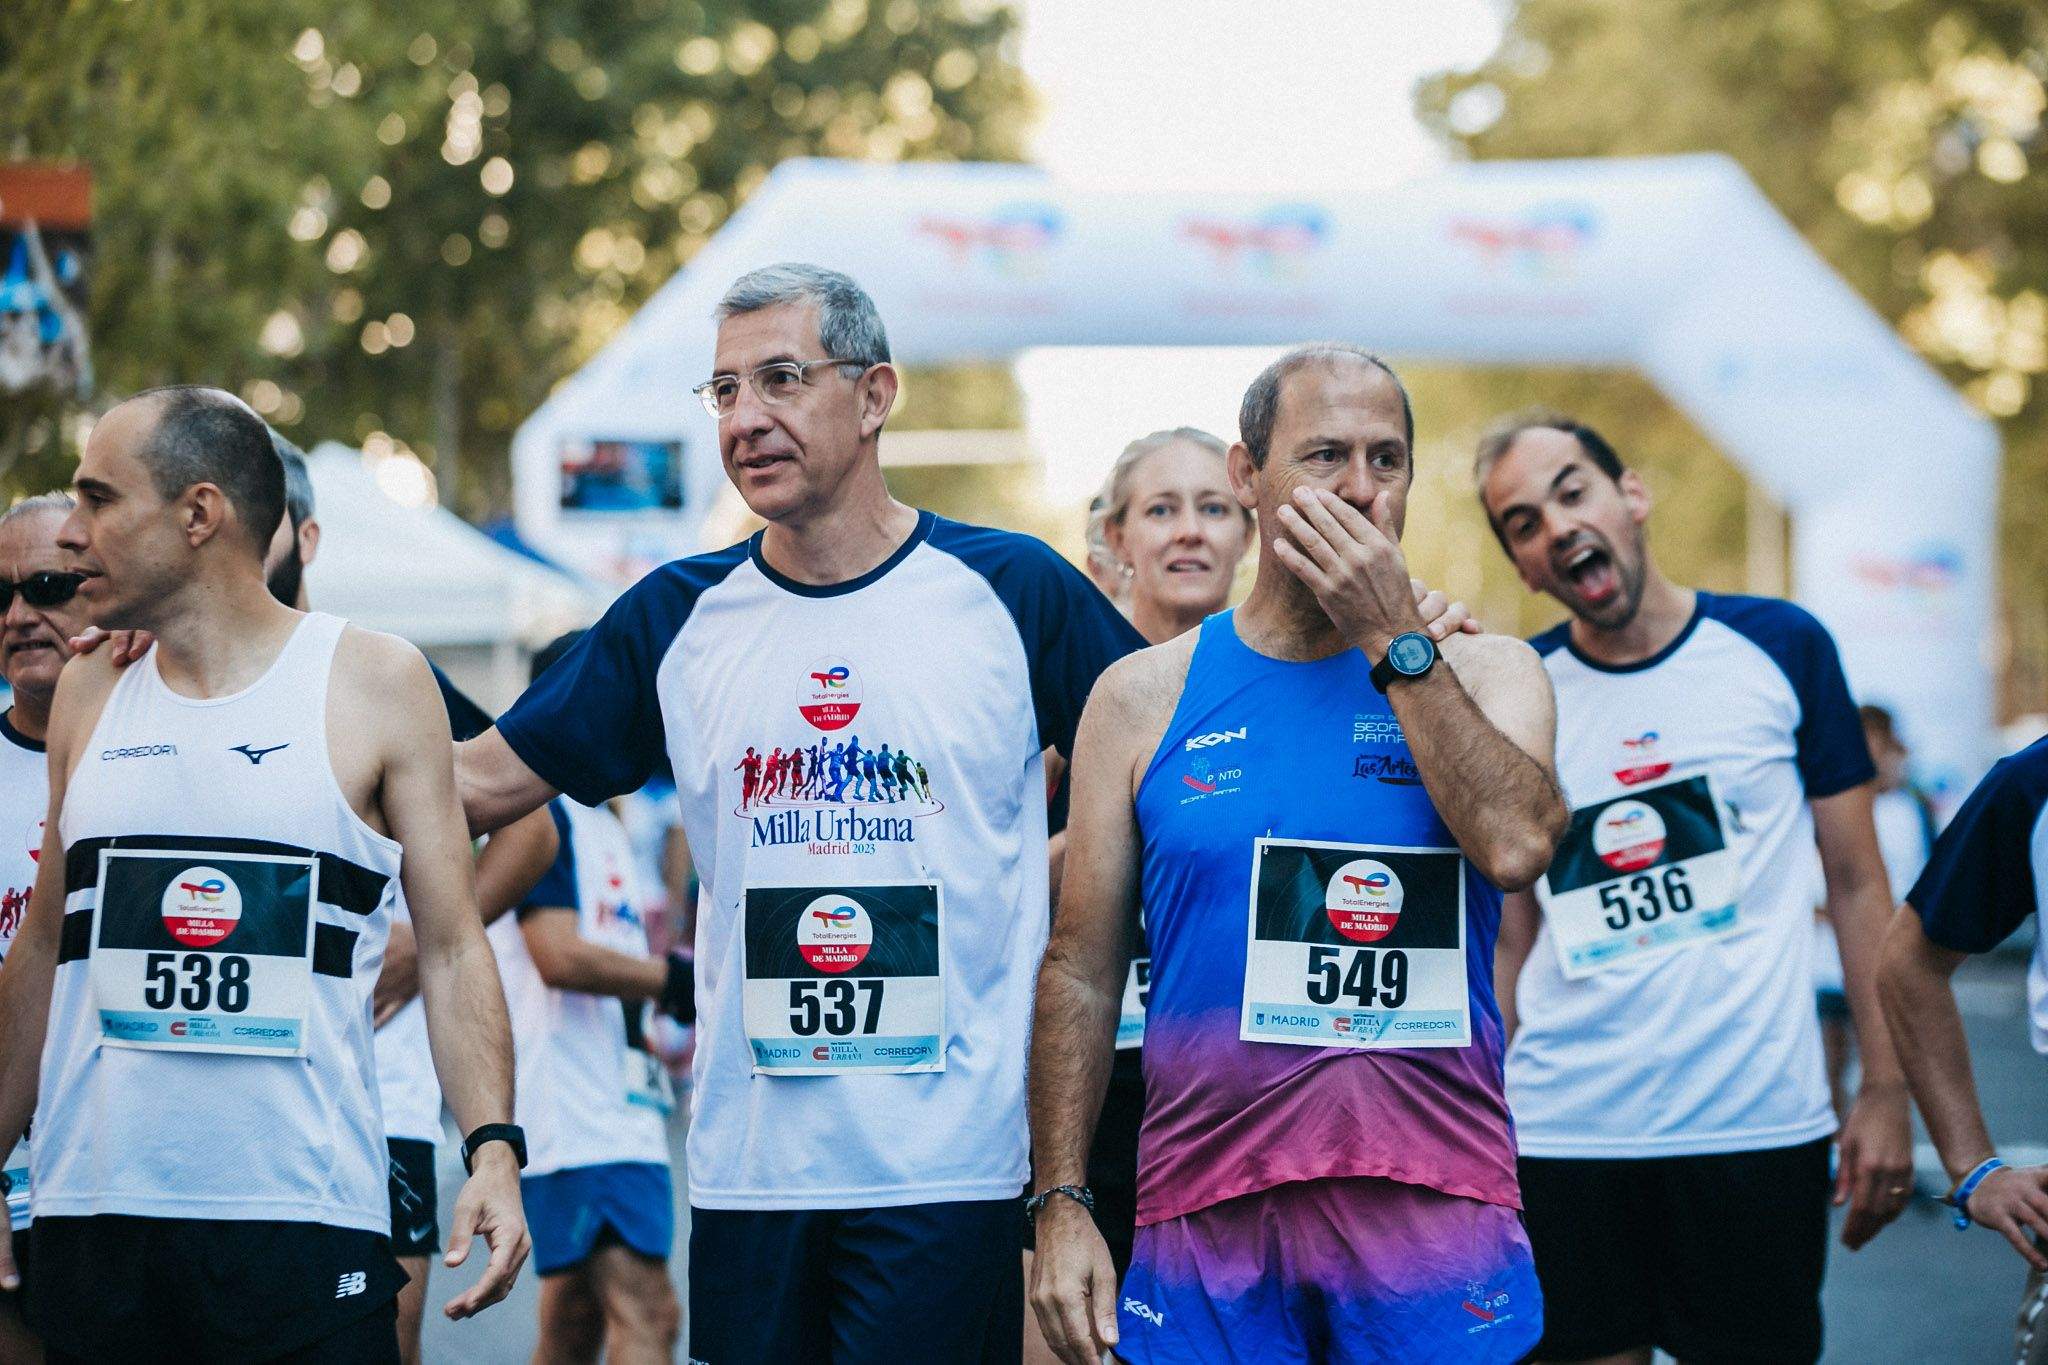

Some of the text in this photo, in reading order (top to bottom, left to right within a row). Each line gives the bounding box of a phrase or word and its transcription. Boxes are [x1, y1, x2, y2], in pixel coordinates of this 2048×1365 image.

[811, 692, 849, 700] Totalnergies
[1354, 722, 1400, 732] SEOA
[1353, 733, 1406, 743] PAMP
[751, 808, 915, 848] Milla Urbana
[807, 842, 876, 856] Madrid 2023
[1342, 898, 1390, 908] TotalEnergies
[1599, 866, 1695, 931] 536
[1351, 913, 1379, 922] MILLA
[1341, 921, 1389, 932] DE MADRID
[812, 932, 857, 940] TotalEnergies
[822, 946, 848, 954] MILLA
[812, 954, 858, 963] DE MADRID
[1307, 945, 1409, 1009] 549
[145, 952, 250, 1013] 538
[789, 979, 884, 1037] 537
[1271, 1014, 1320, 1027] MADRID
